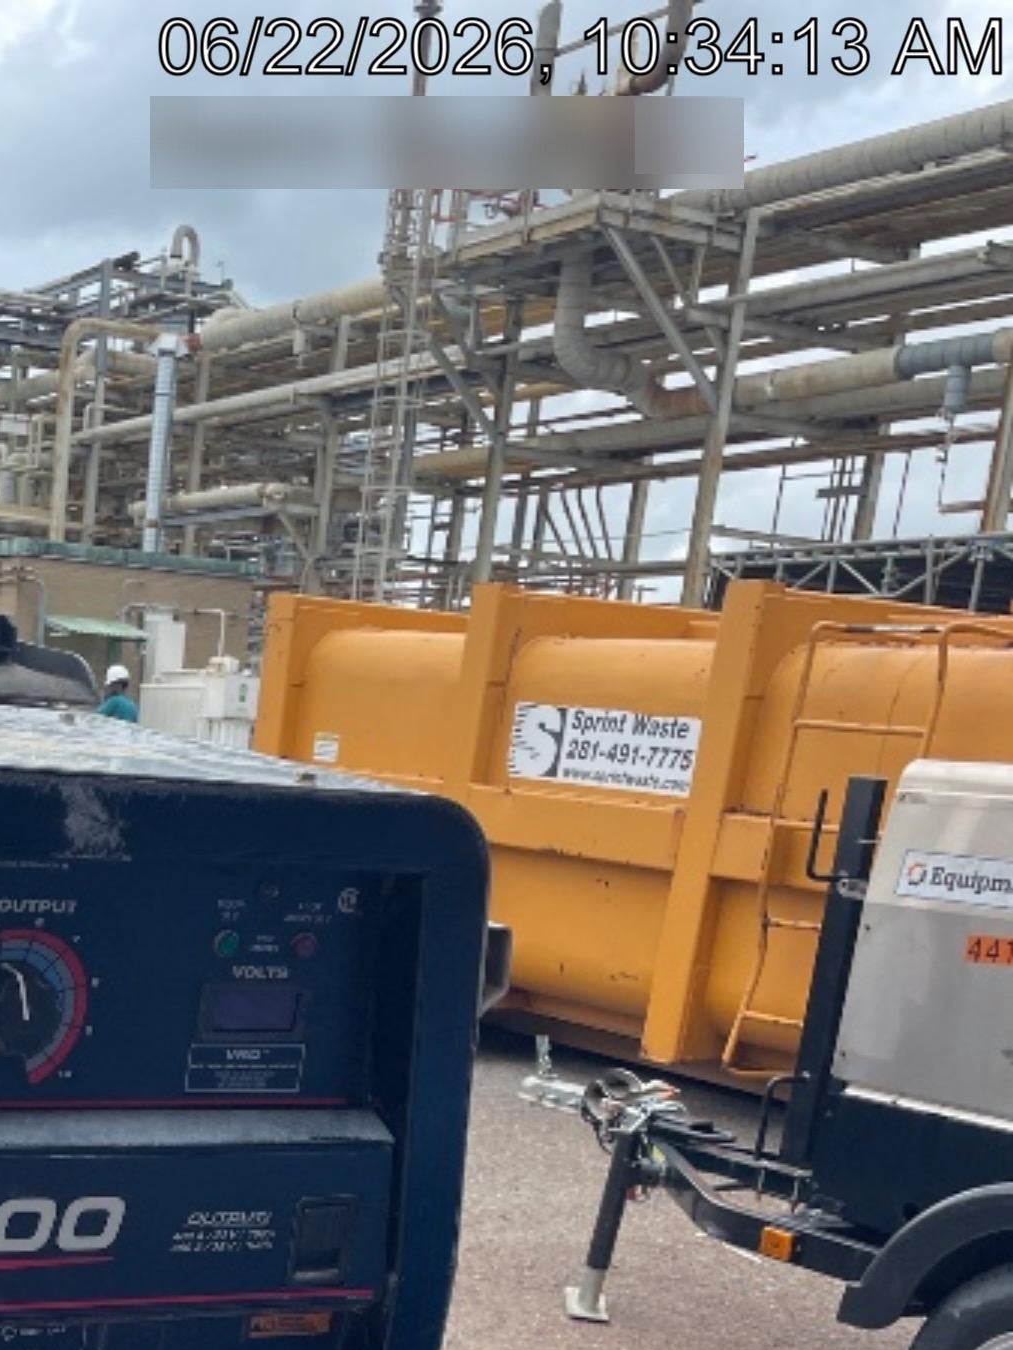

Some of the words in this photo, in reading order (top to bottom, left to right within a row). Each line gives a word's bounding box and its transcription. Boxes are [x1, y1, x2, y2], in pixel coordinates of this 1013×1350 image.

[571, 709, 628, 736] Sprint
[631, 713, 690, 739] Waste
[565, 738, 694, 770] 281-491-7775
[232, 964, 289, 979] VOLTS
